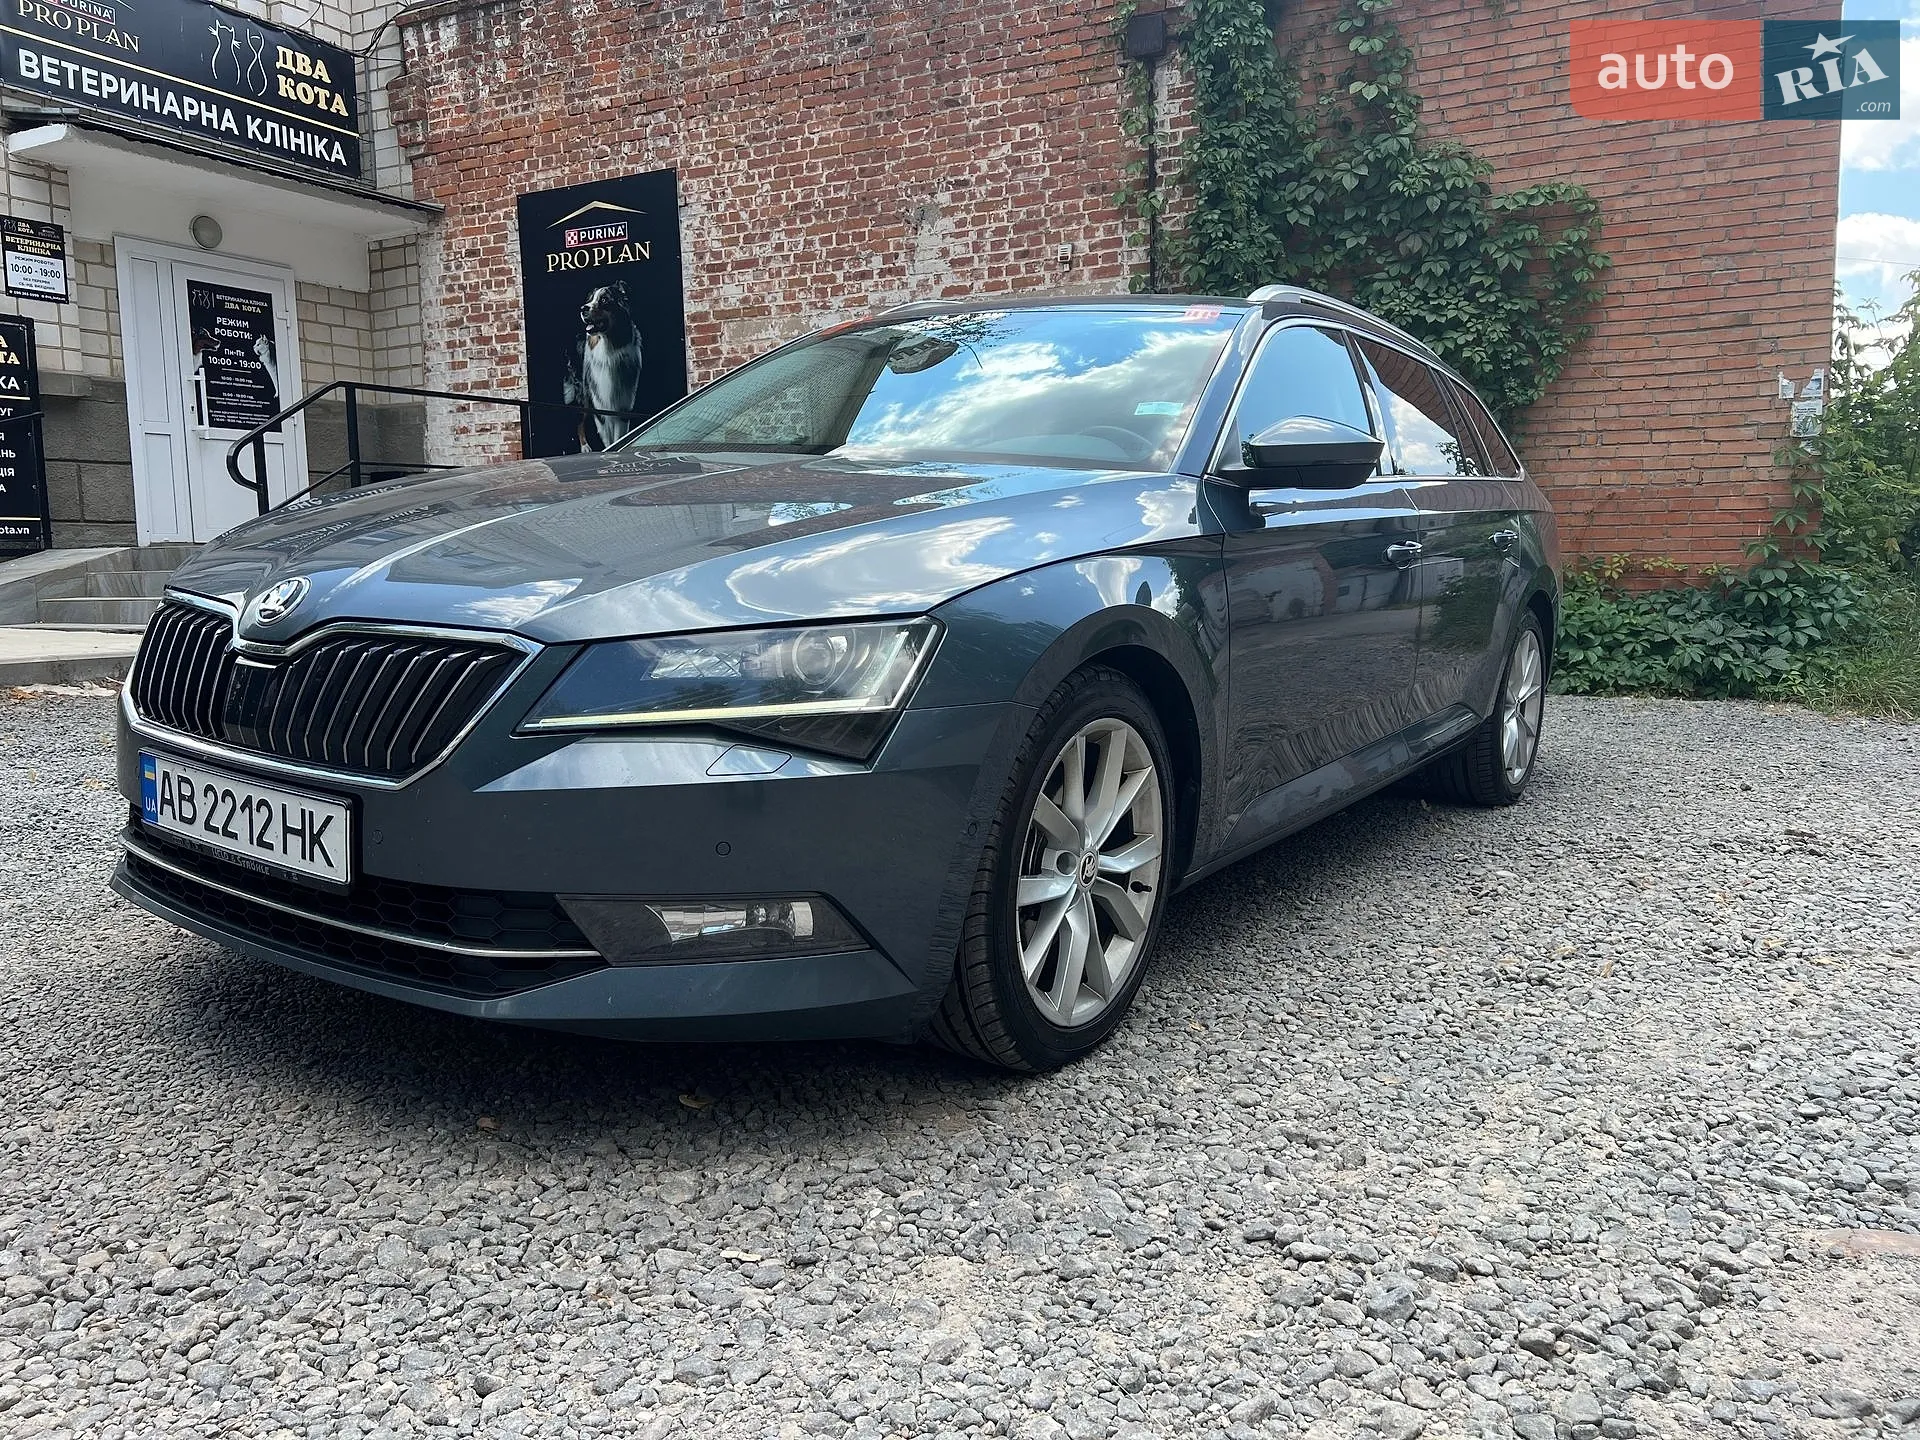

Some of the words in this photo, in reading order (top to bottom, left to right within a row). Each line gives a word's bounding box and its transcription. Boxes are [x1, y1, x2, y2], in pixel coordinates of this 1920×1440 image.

[17, 0, 72, 30] PRO
[75, 16, 140, 53] PLAN
[275, 45, 332, 84] ДВА
[277, 74, 349, 117] КОТА
[18, 48, 240, 136] ВЕТЕРИНАРНА
[247, 114, 348, 167] КЛІНІКА
[579, 226, 625, 242] PURINA
[5, 235, 62, 252] ВЕТЕРИНАРНА
[546, 248, 590, 273] PRO
[592, 241, 651, 268] PLAN
[10, 263, 33, 275] 10:00
[40, 267, 61, 279] 19:00
[216, 317, 249, 329] РЕЖИМ
[214, 328, 253, 340] РОБОТИ:
[208, 356, 232, 366] 10:00
[239, 359, 262, 370] 19:00
[0, 525, 30, 535] ota.vn
[145, 797, 157, 813] UA
[159, 770, 197, 825] AB
[203, 782, 274, 851] 2212
[281, 802, 335, 868] HK
